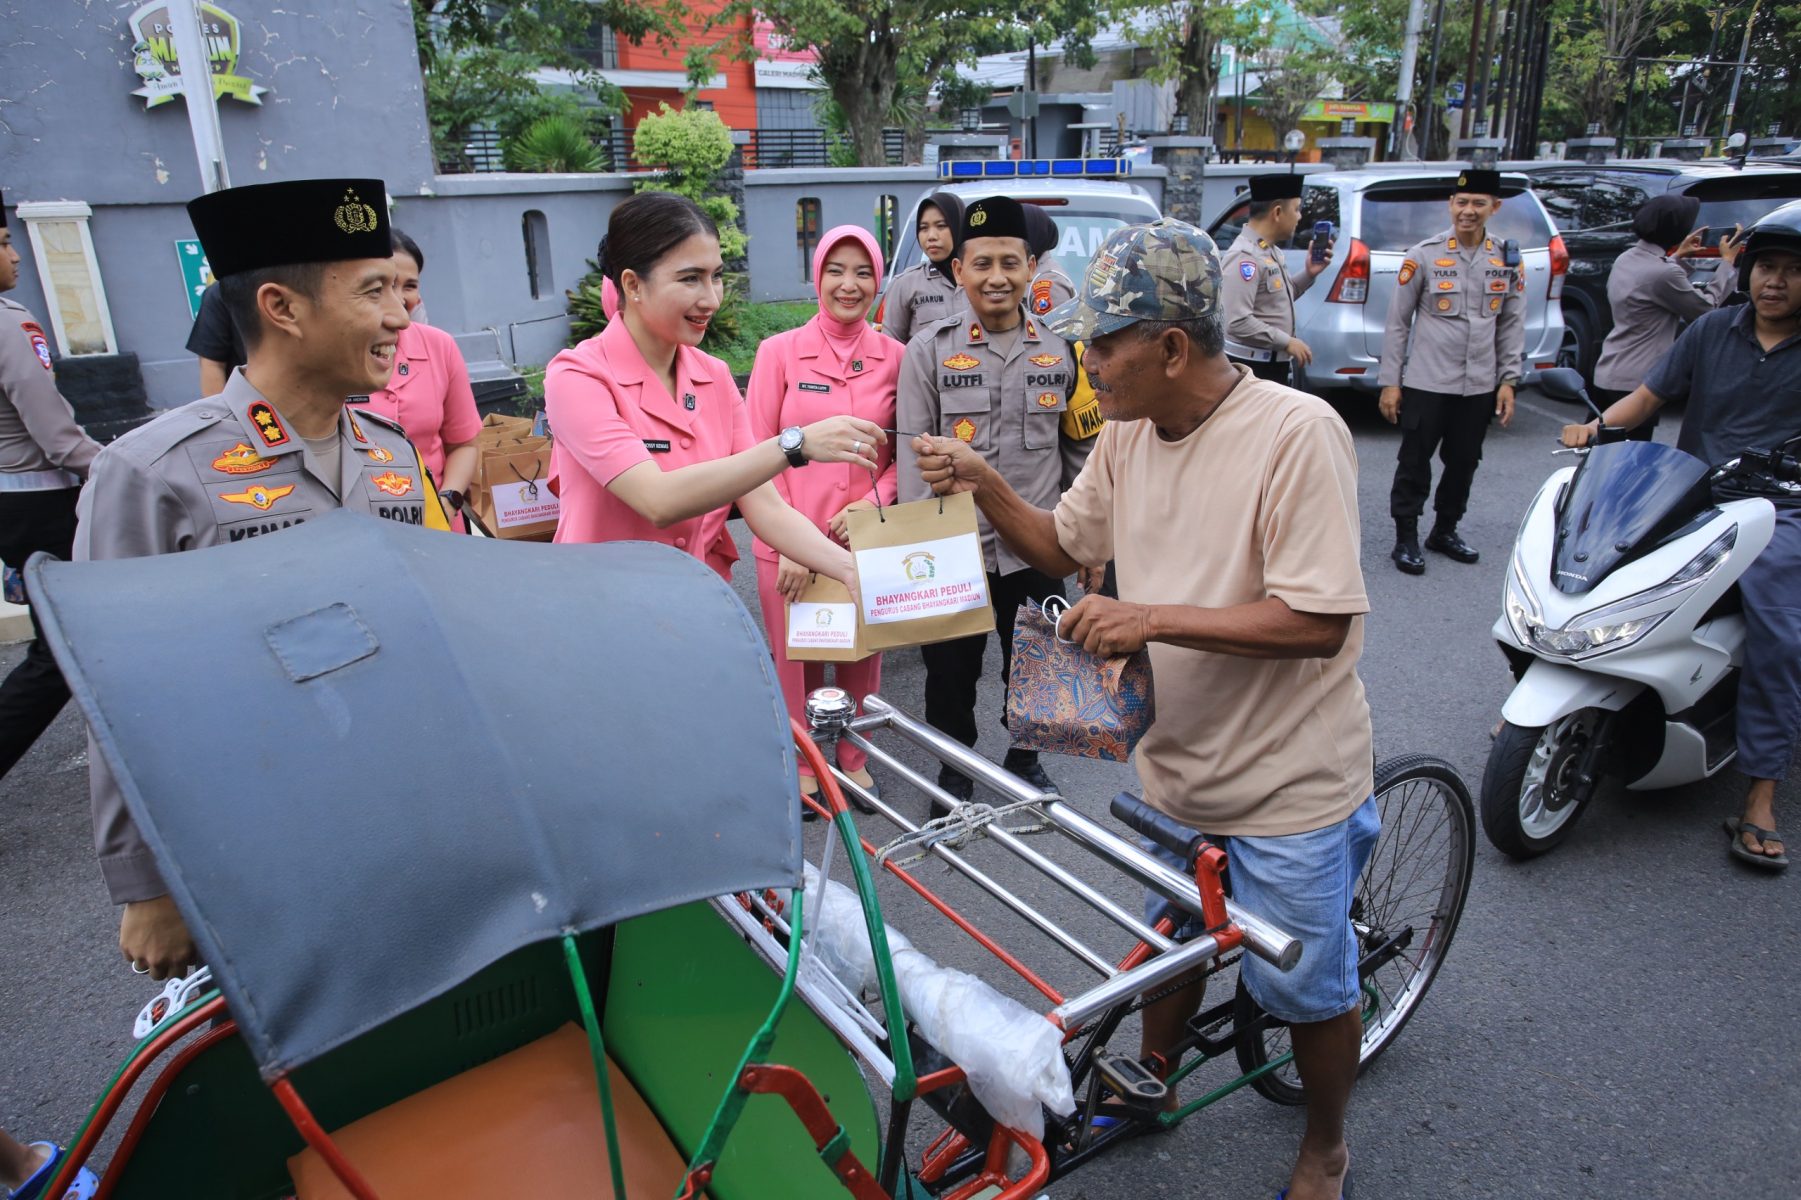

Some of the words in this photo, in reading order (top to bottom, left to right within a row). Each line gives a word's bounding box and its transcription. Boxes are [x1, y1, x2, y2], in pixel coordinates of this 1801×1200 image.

[1433, 269, 1458, 278] YULIS
[943, 373, 983, 388] LUTFI
[1026, 373, 1067, 387] POLRI
[1556, 570, 1588, 582] HONDA
[875, 587, 939, 607] BHAYANGKARI
[940, 581, 972, 597] PEDULI
[870, 606, 899, 617] PENGURUS
[900, 603, 922, 613] CABANG
[922, 598, 960, 610] BHAYANGKARI
